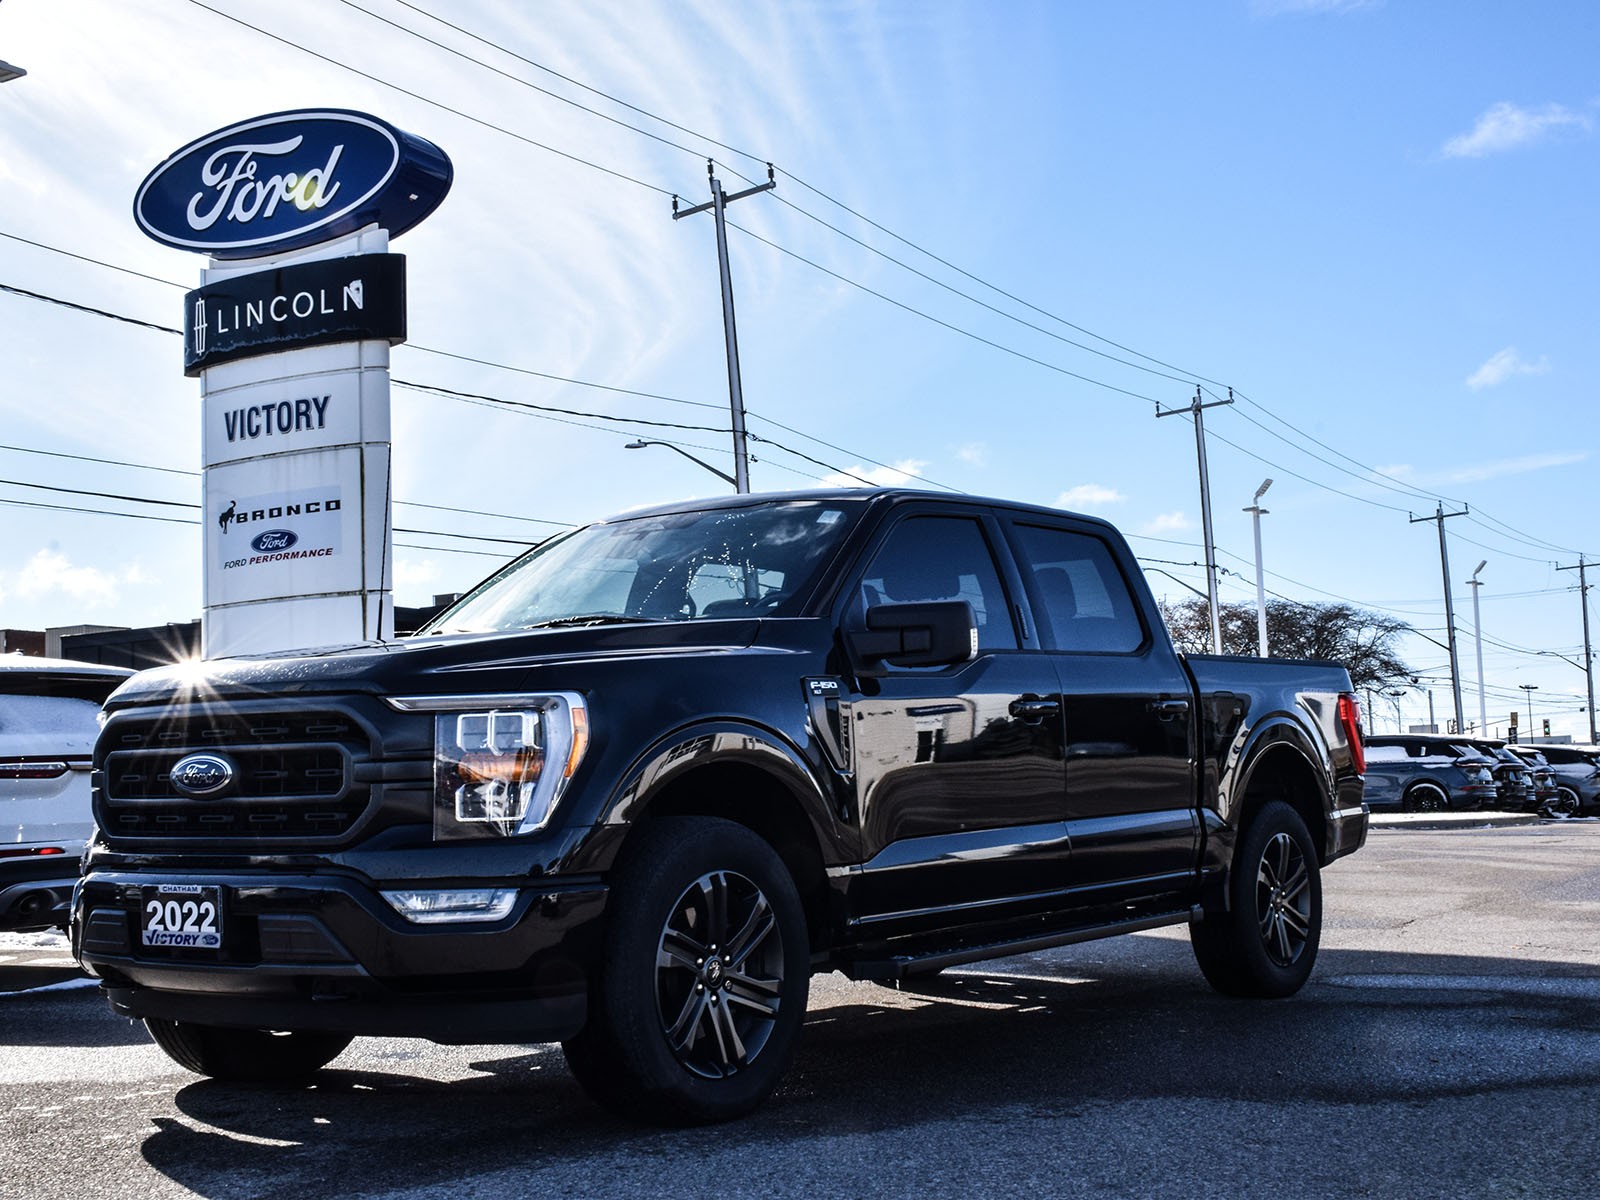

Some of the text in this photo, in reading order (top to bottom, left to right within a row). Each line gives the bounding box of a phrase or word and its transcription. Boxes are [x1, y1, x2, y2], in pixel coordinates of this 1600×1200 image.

[187, 135, 344, 231] Ford
[217, 279, 363, 333] LINCOLN
[224, 395, 332, 442] VICTORY
[236, 499, 341, 524] BRONCO
[259, 533, 288, 550] Ford
[224, 548, 333, 570] FORD PERFORMANCE
[146, 900, 216, 933] 2022
[146, 929, 199, 945] VICTORY
